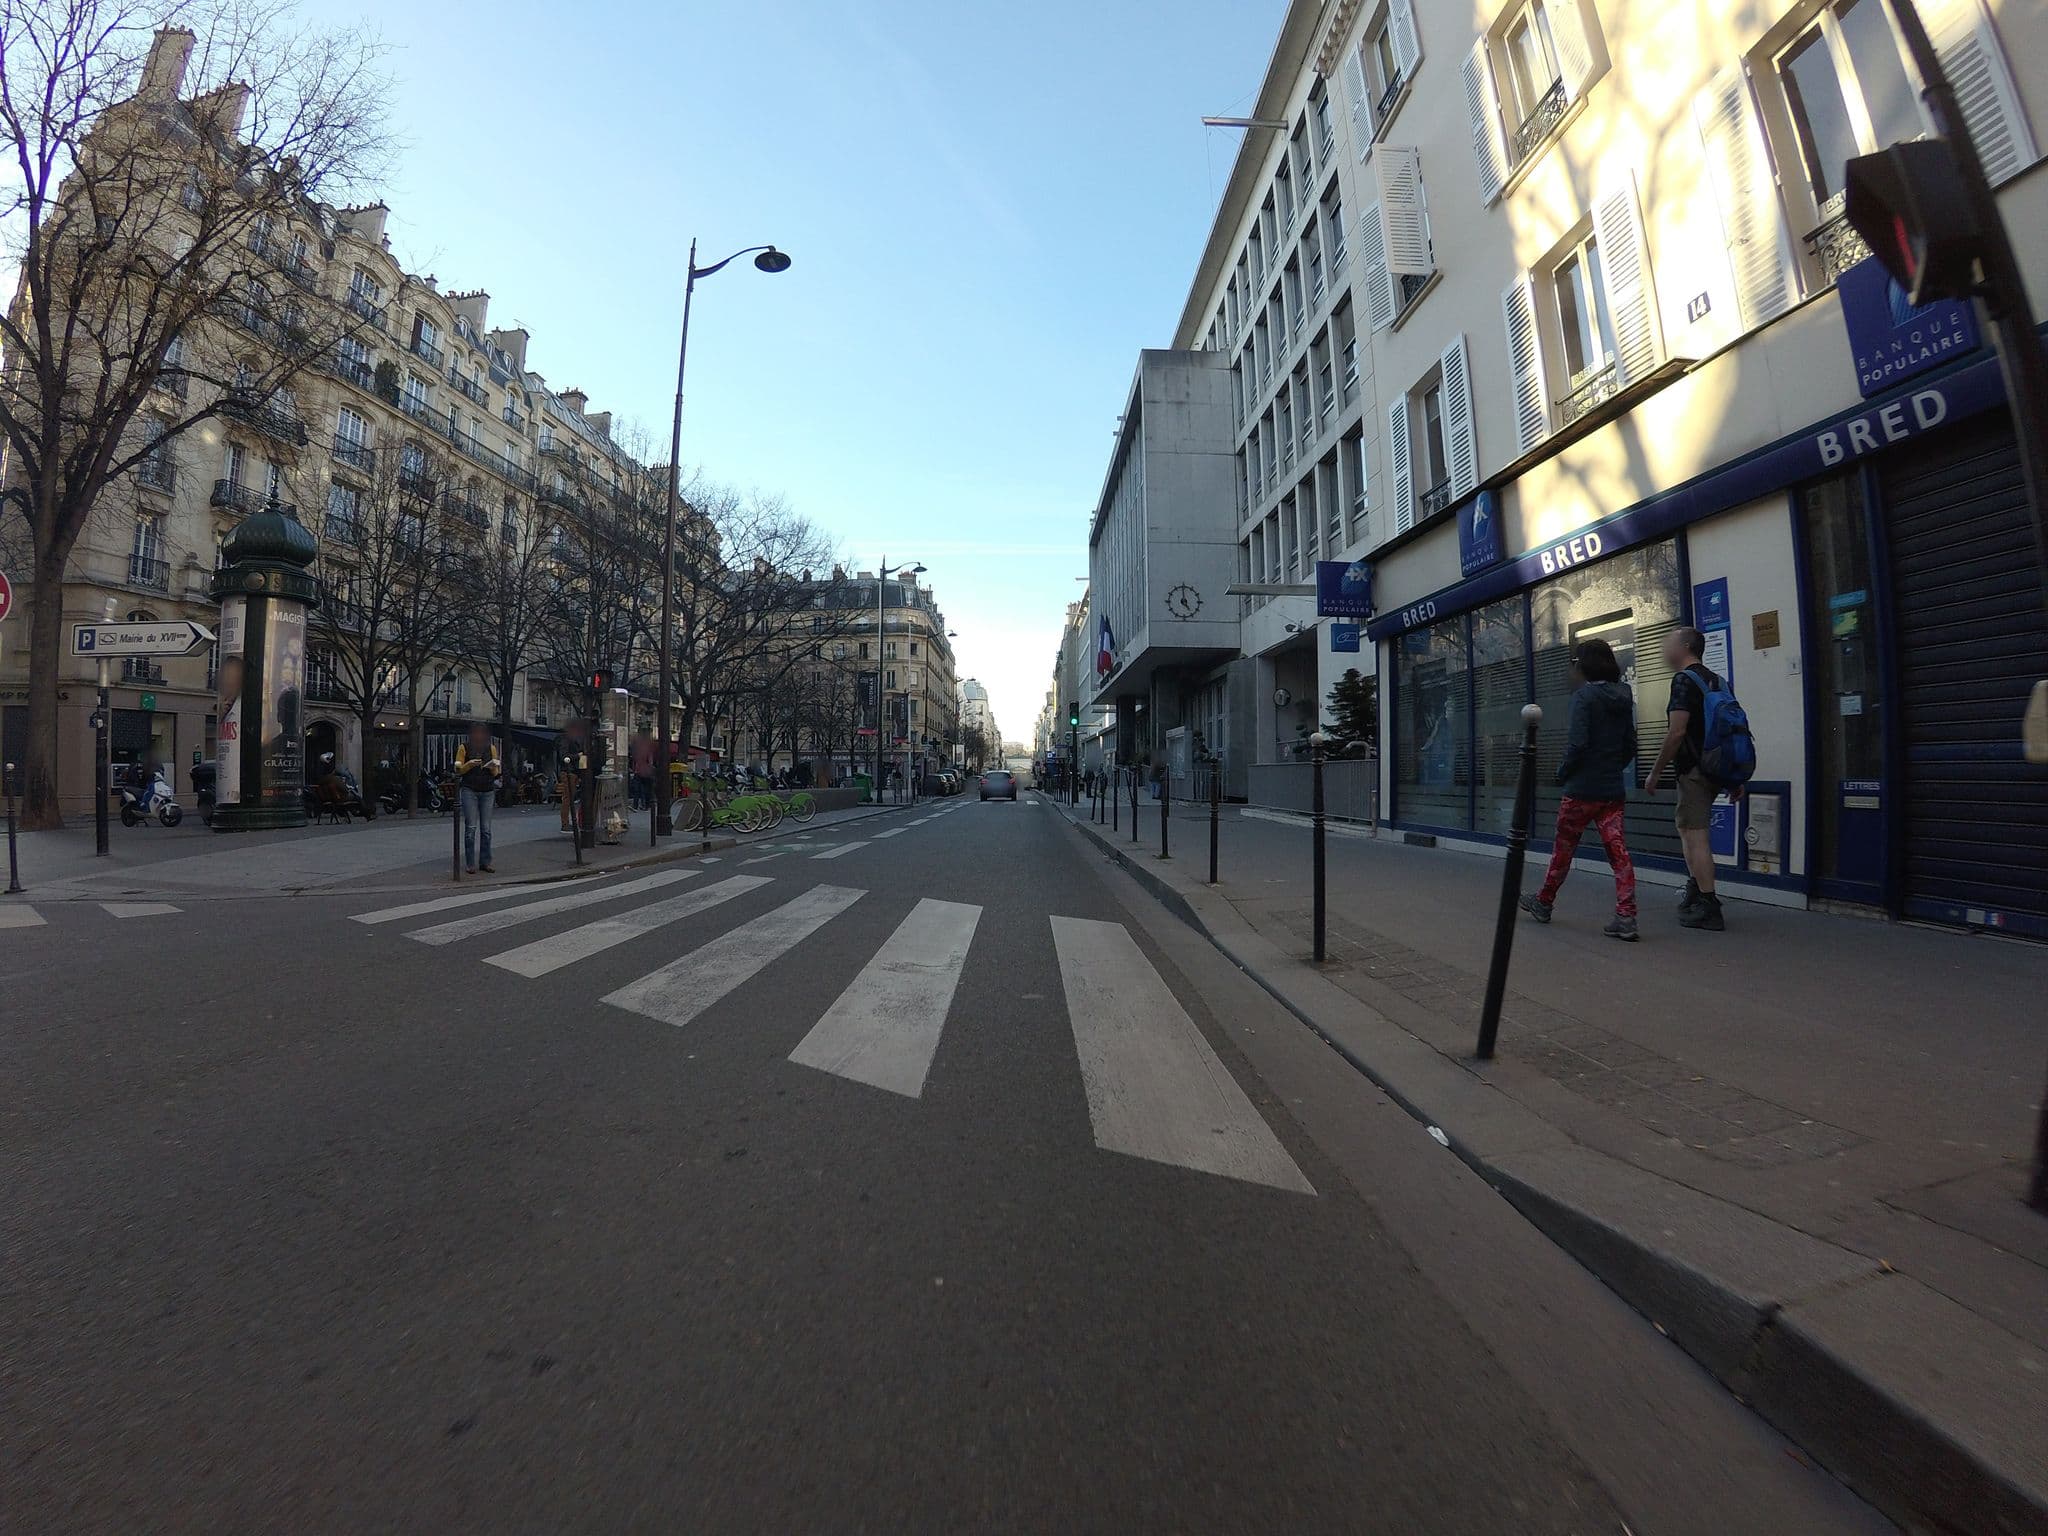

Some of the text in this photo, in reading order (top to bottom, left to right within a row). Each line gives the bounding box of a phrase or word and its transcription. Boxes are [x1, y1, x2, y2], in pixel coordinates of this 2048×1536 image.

[1690, 295, 1707, 321] 14
[1858, 312, 1961, 369] BANQUE
[1862, 330, 1965, 386] POPULAIRE
[1816, 389, 1948, 468] BRED
[1462, 552, 1495, 571] POPULAIRE
[1540, 532, 1602, 575] BRED
[1402, 601, 1436, 628] BRED
[82, 632, 92, 648] P
[119, 633, 144, 643] Mairie
[146, 633, 157, 643] du
[1843, 781, 1881, 790] LETTRES
